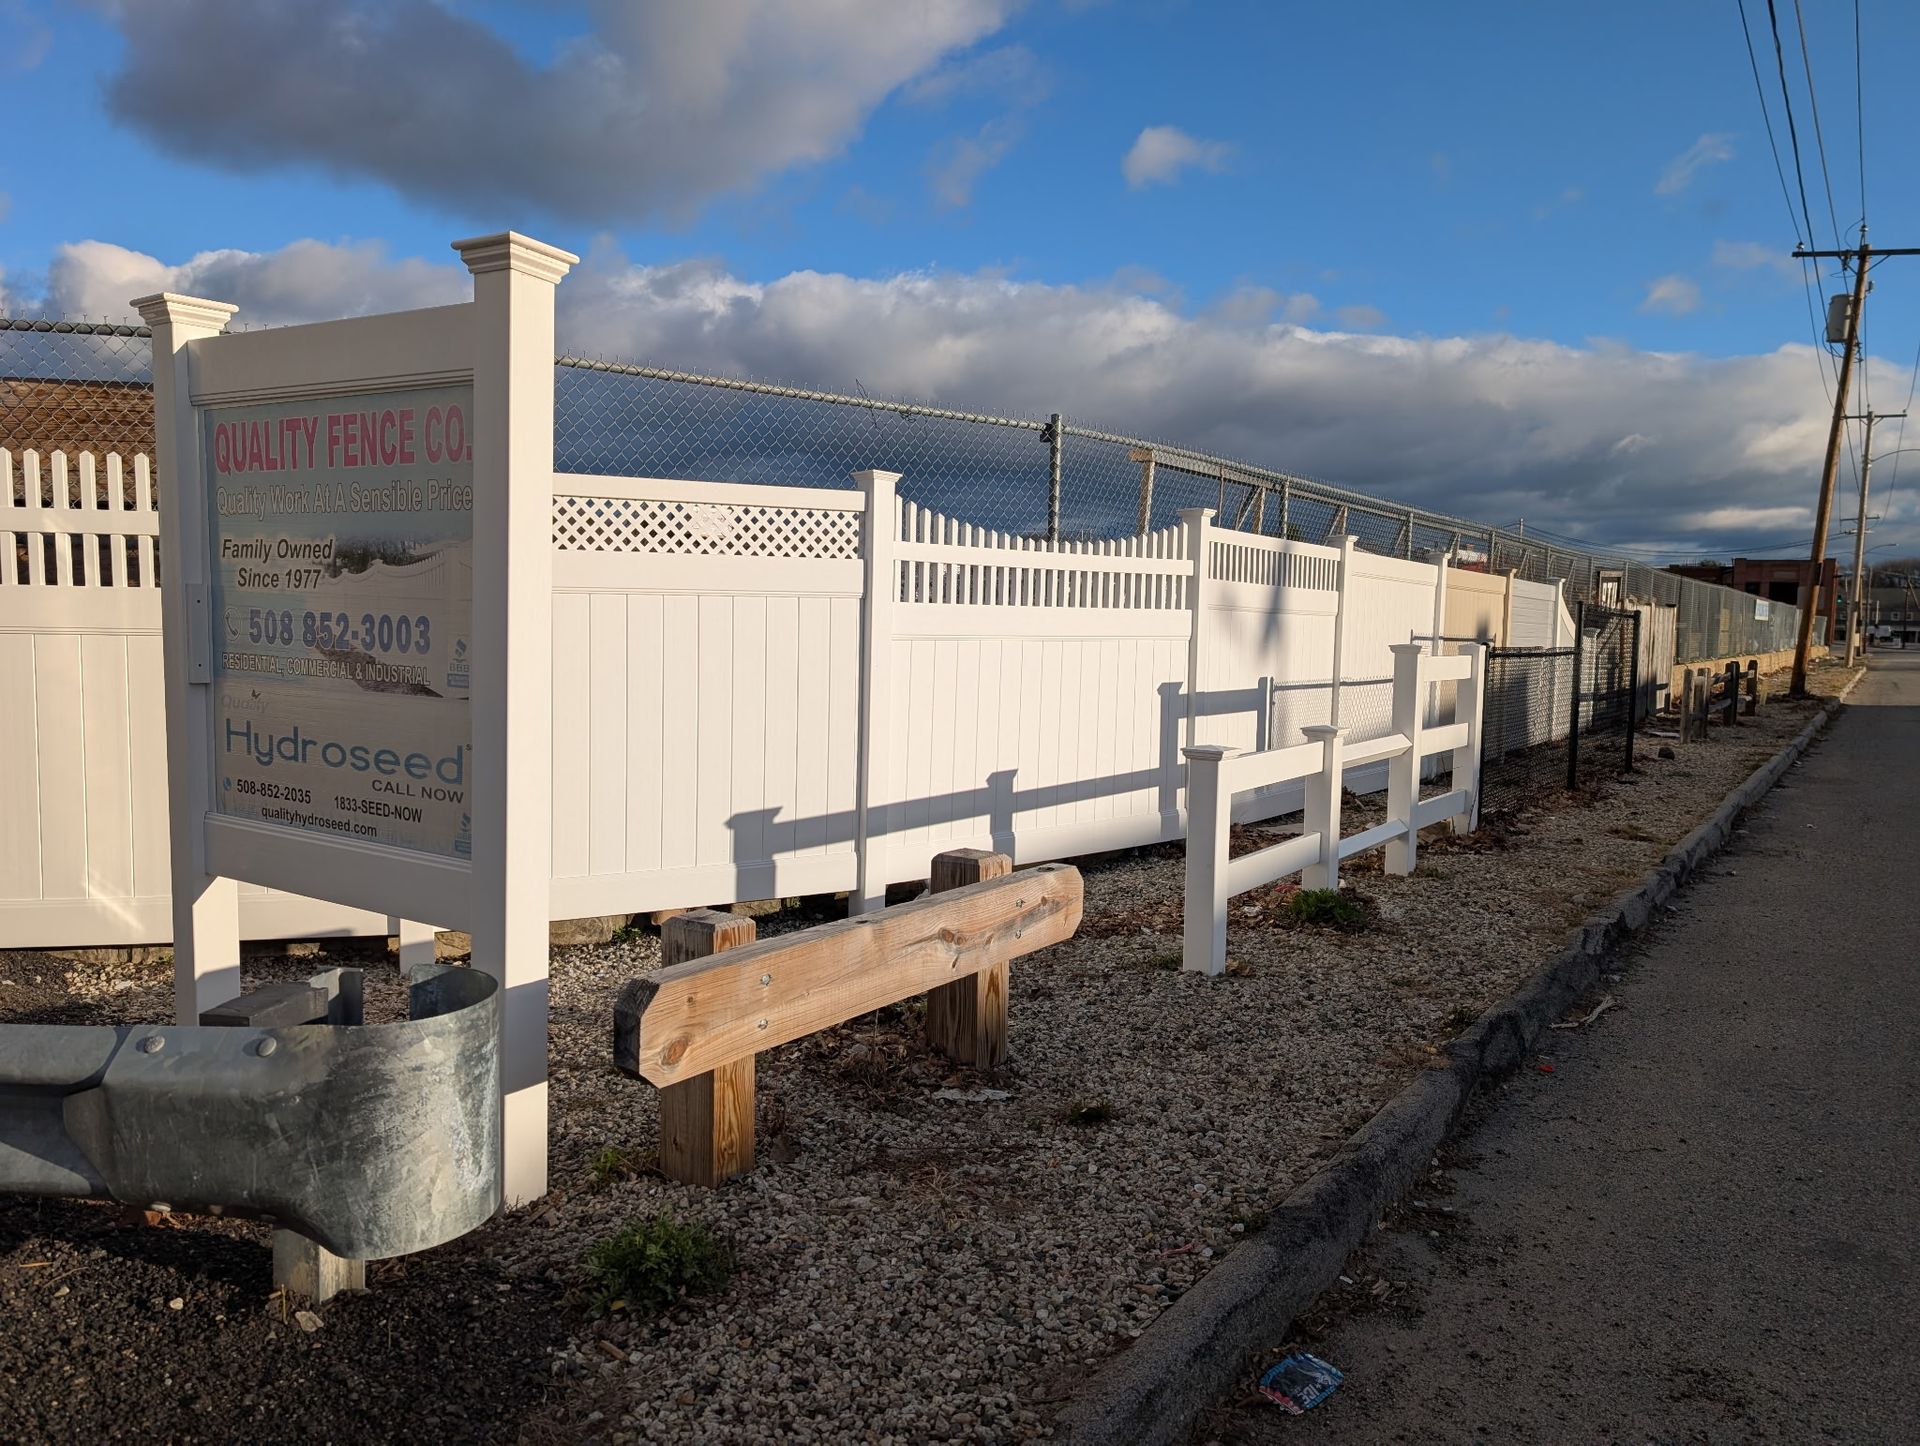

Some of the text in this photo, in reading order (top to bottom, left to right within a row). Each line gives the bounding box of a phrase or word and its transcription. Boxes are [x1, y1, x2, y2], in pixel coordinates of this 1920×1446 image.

[214, 403, 472, 477] QUALITY FENCE CO.
[217, 478, 473, 521] Quality Work At A Sensible Price
[222, 538, 333, 564] Family Owned
[237, 568, 322, 589] Since 1977
[248, 608, 431, 655] 508 852-3003
[222, 652, 285, 675] RESIDENTIAL,
[287, 656, 354, 680] COMMERCIAL
[355, 664, 363, 678] &
[365, 661, 431, 686] INDUSTRIAL
[225, 718, 464, 785] Hydroseed
[236, 778, 423, 823] 508-852-2035 1833-SEED-NOW
[371, 779, 465, 804] CALL NOW
[261, 805, 378, 838] qualityhydroseed.com
